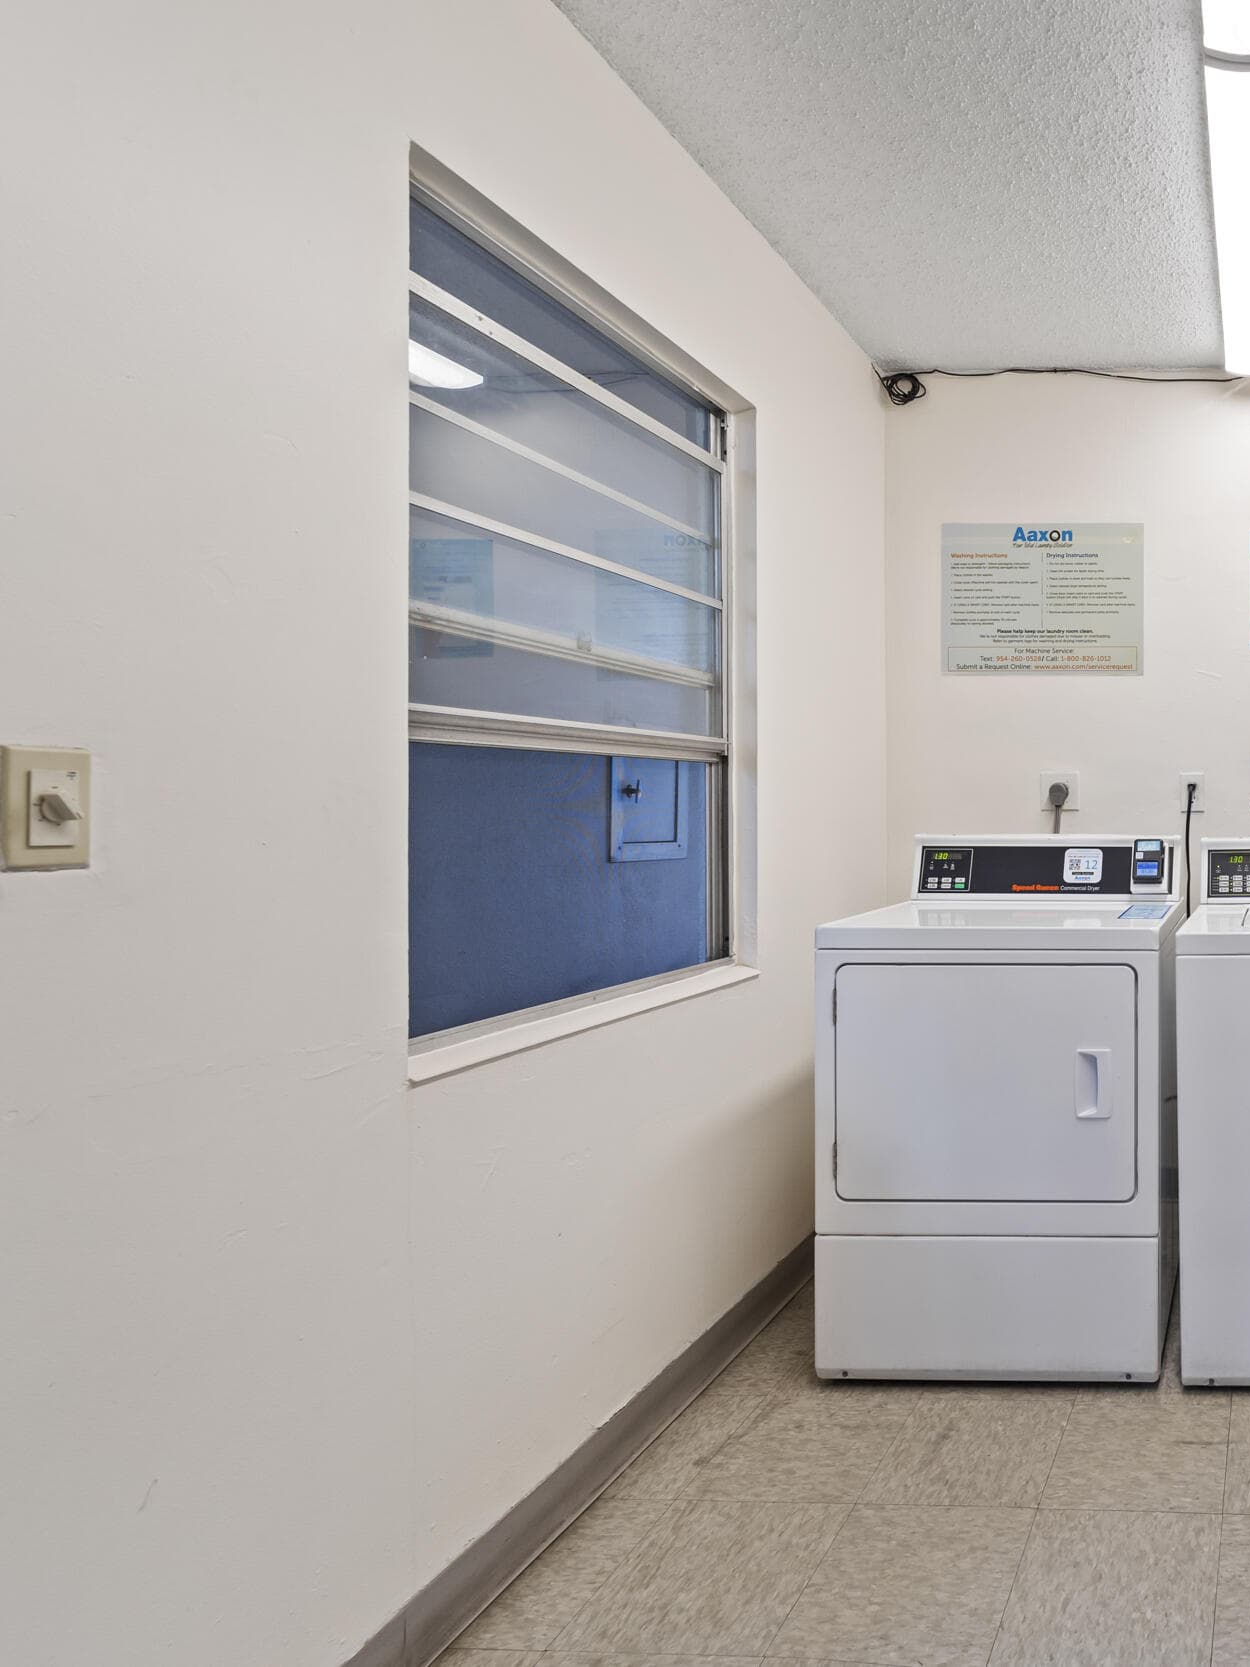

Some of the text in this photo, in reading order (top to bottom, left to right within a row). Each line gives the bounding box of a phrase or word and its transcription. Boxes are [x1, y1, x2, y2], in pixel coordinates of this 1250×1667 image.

[1012, 526, 1073, 542] Aaxon
[985, 663, 1009, 671] Request
[1084, 859, 1099, 870] 12
